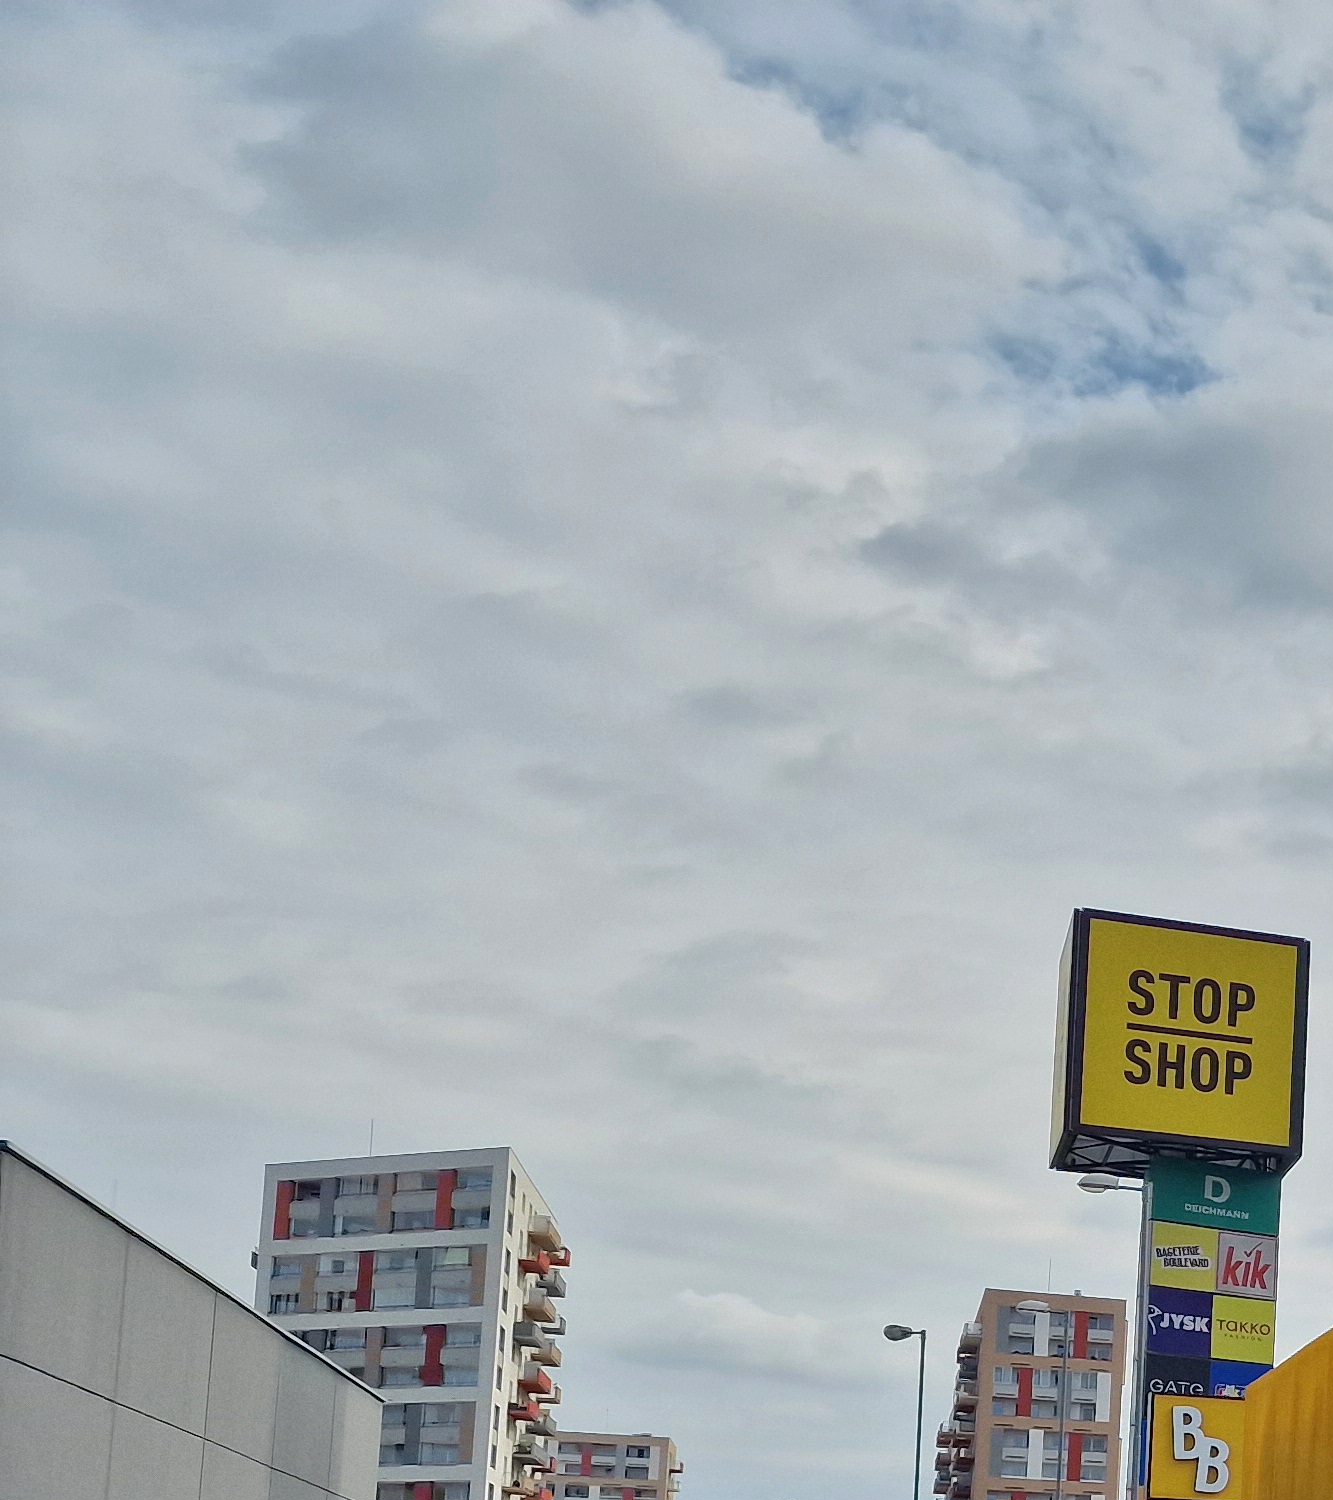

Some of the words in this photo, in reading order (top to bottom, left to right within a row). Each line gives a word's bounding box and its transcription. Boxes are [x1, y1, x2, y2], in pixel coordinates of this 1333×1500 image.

[1127, 969, 1255, 1027] STOP
[1124, 1039, 1252, 1095] SHOP
[1204, 1175, 1231, 1203] D
[1160, 1313, 1210, 1333] JYSK
